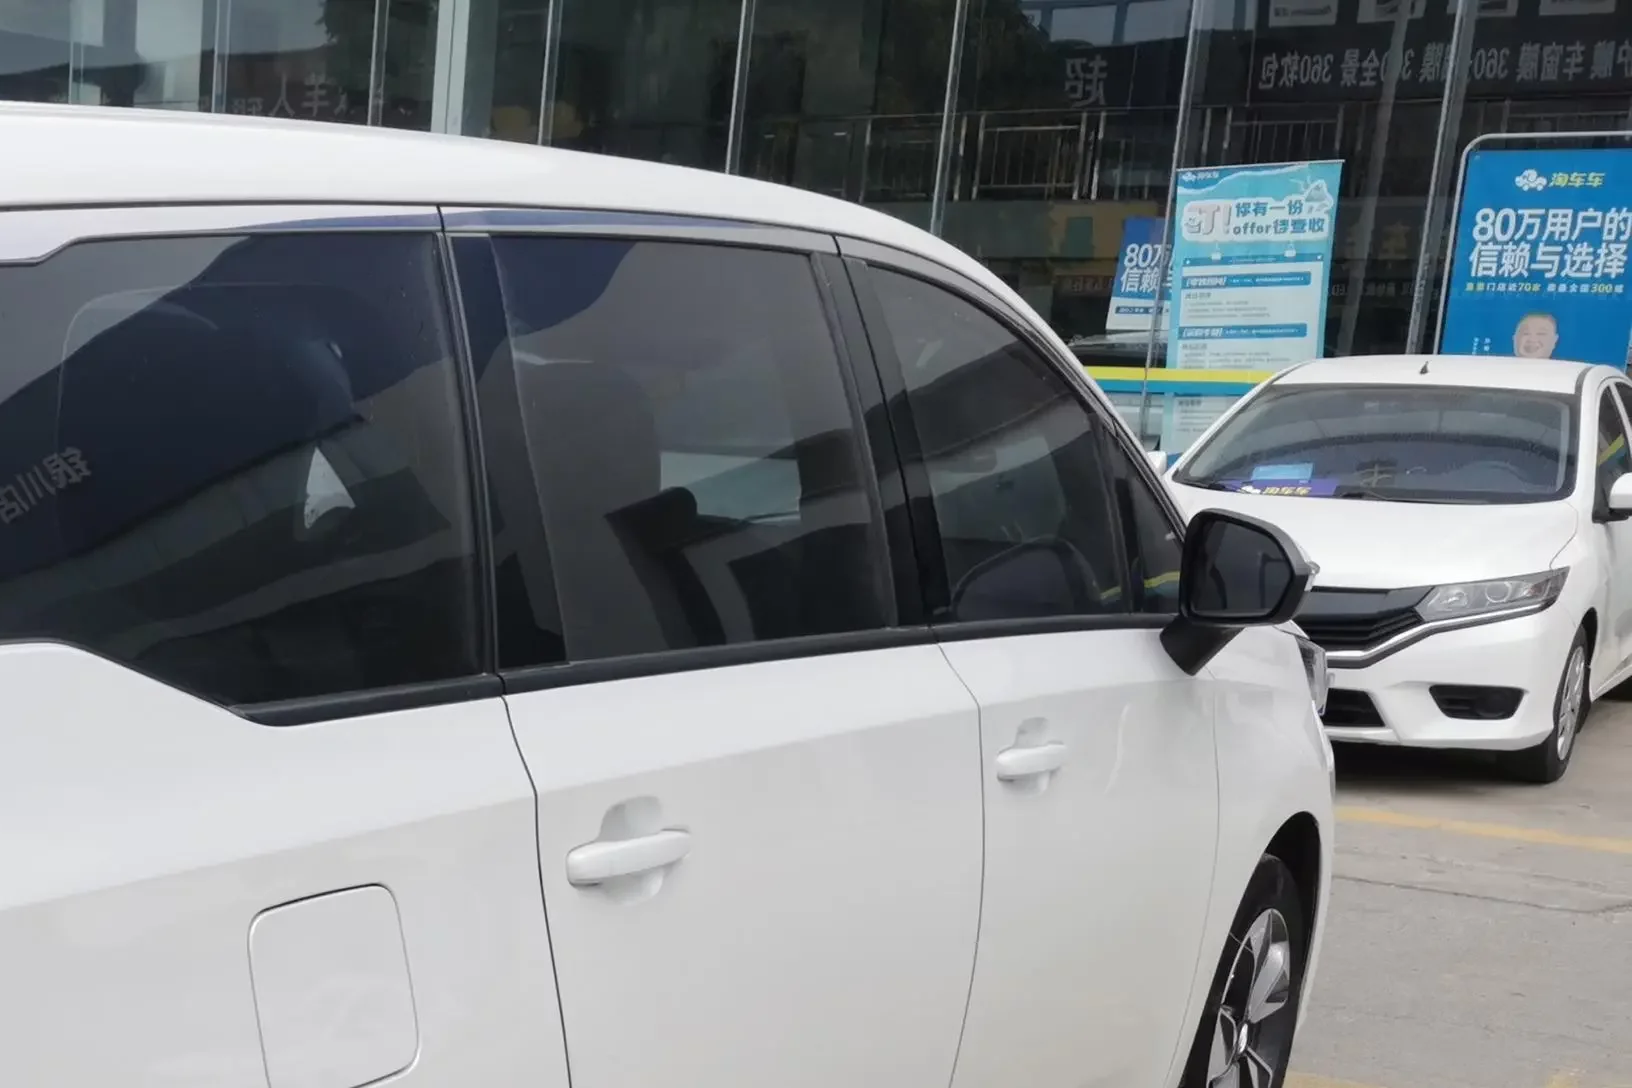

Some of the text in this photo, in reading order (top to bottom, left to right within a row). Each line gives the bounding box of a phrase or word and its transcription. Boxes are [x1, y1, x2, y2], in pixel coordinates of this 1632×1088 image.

[1548, 172, 1606, 188] 淘车车
[1235, 200, 1304, 218] 你有一份
[1472, 207, 1632, 242] 80万用户的
[1469, 242, 1628, 278] 信赖与选择
